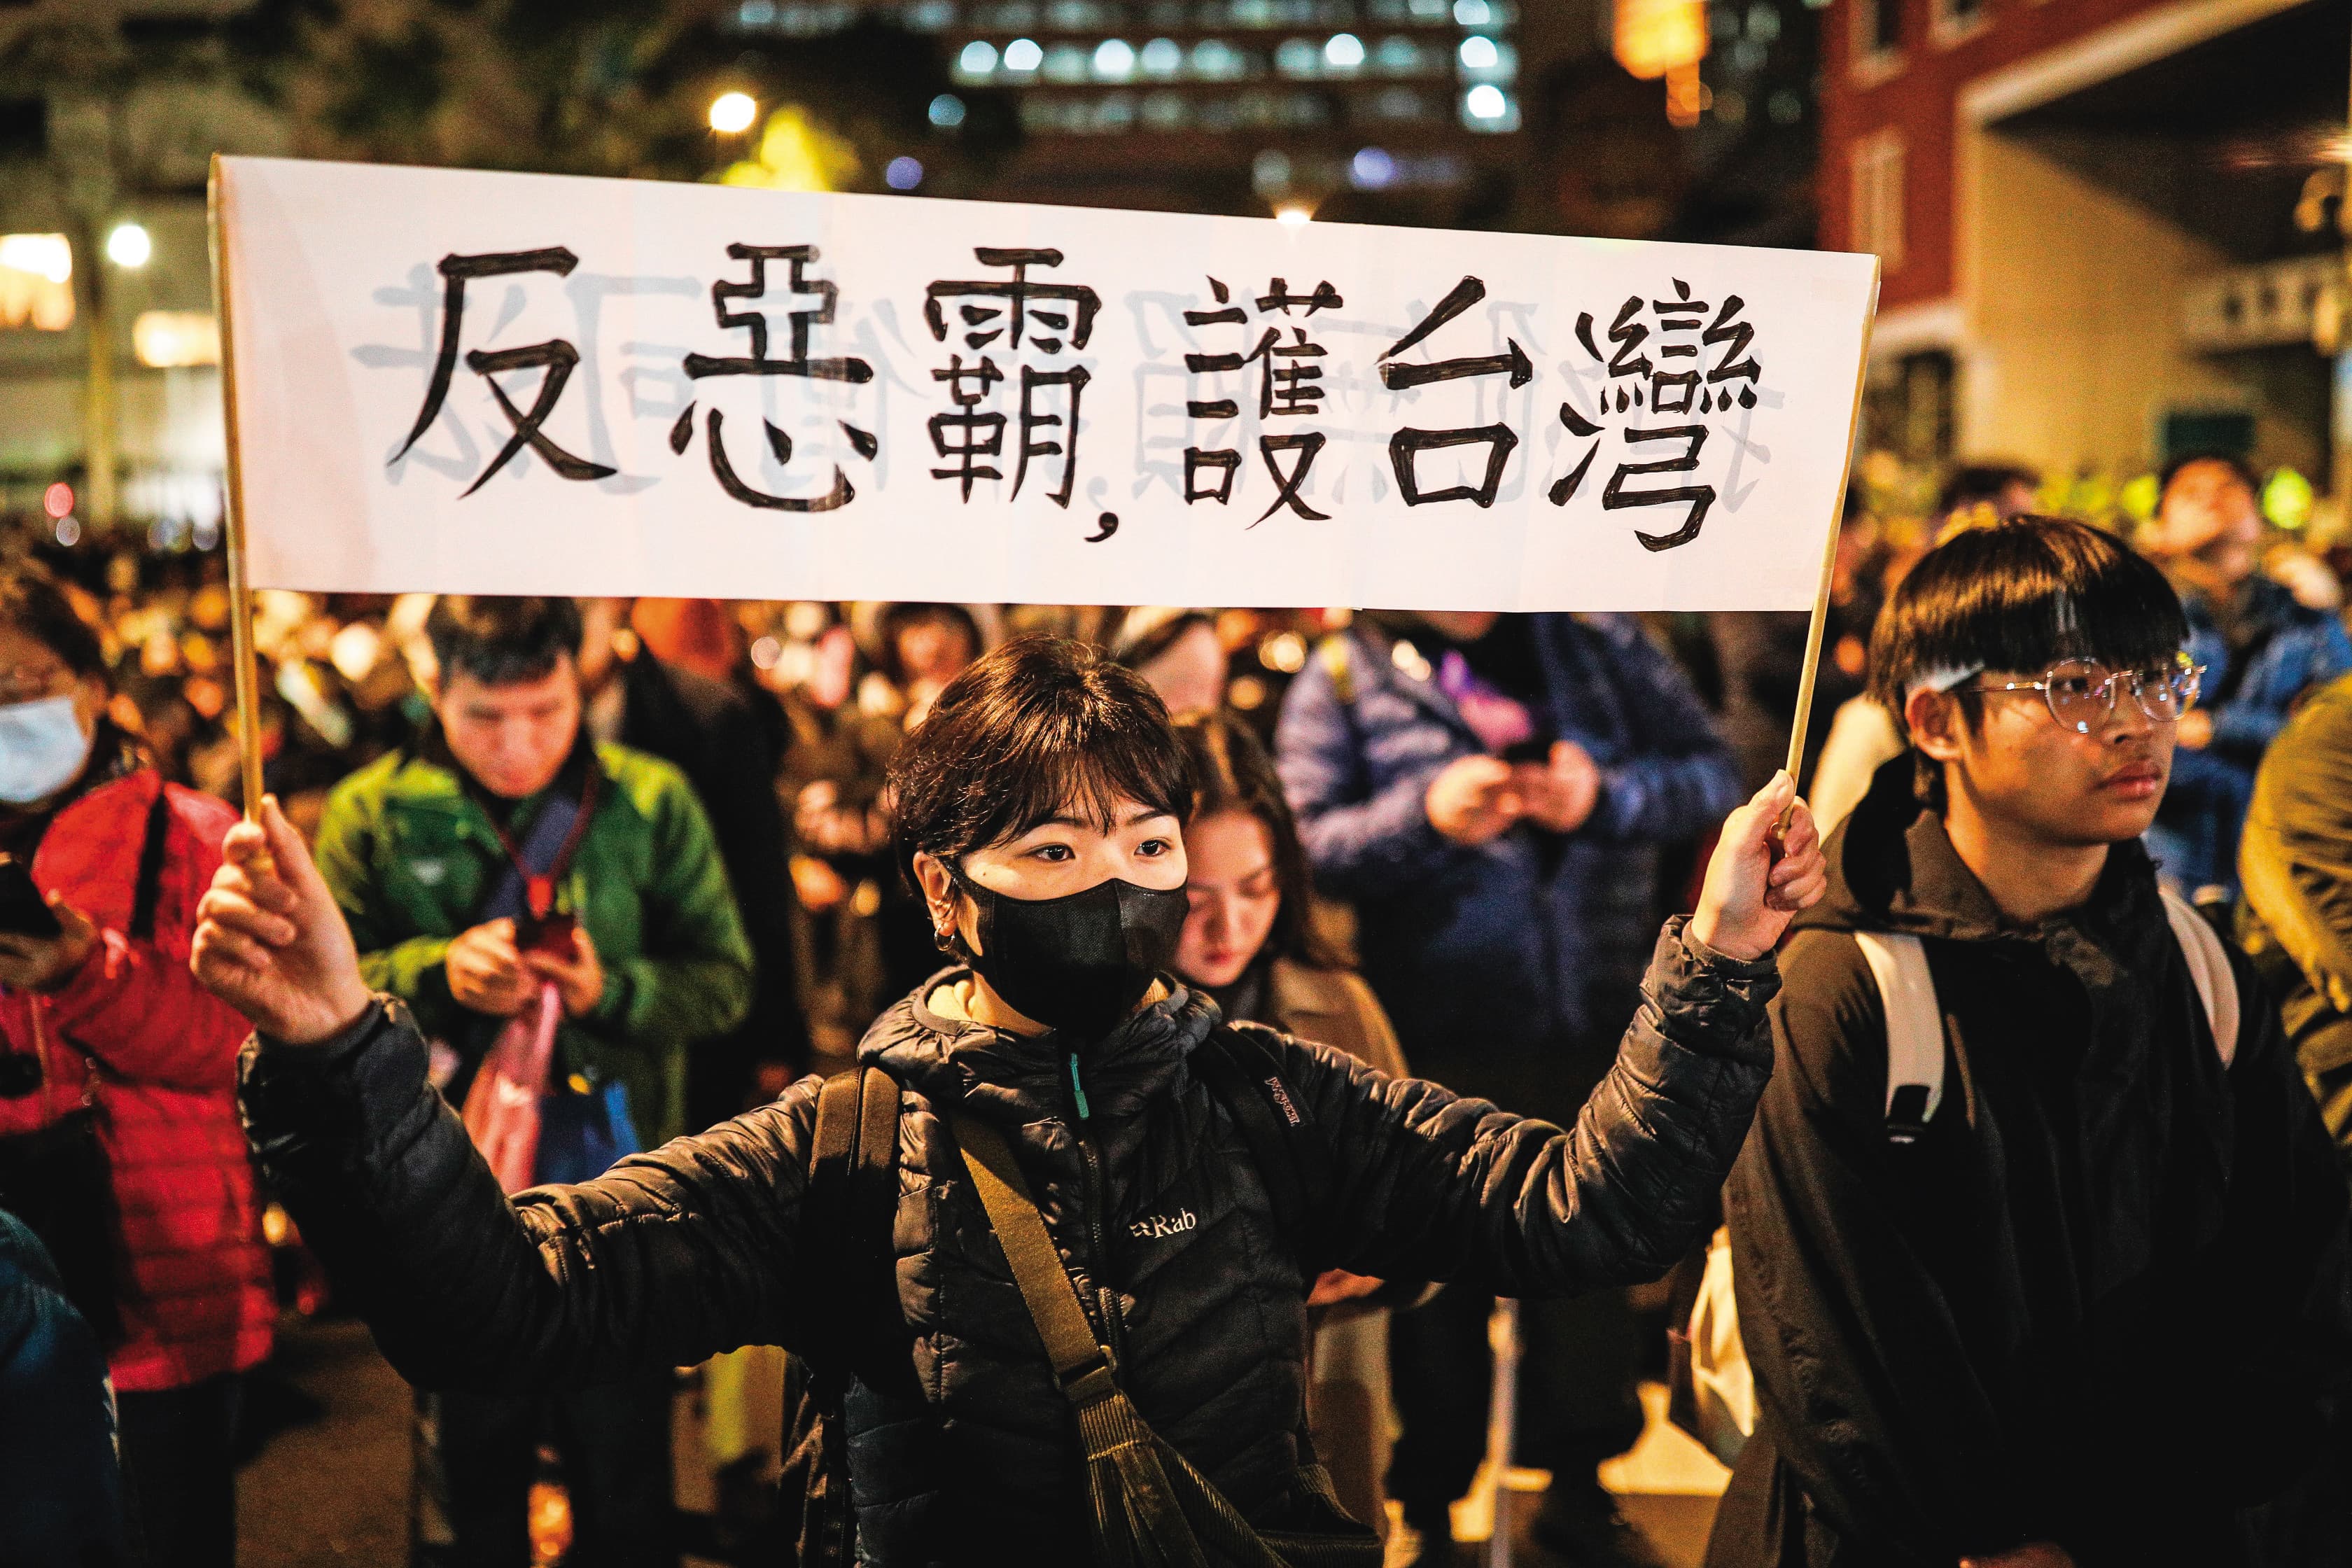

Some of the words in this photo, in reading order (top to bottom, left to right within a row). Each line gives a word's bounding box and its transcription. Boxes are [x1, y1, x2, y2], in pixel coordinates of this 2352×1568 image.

[386, 242, 1762, 552] 反惡霸，護台灣
[1149, 1208, 1196, 1238] Rab
